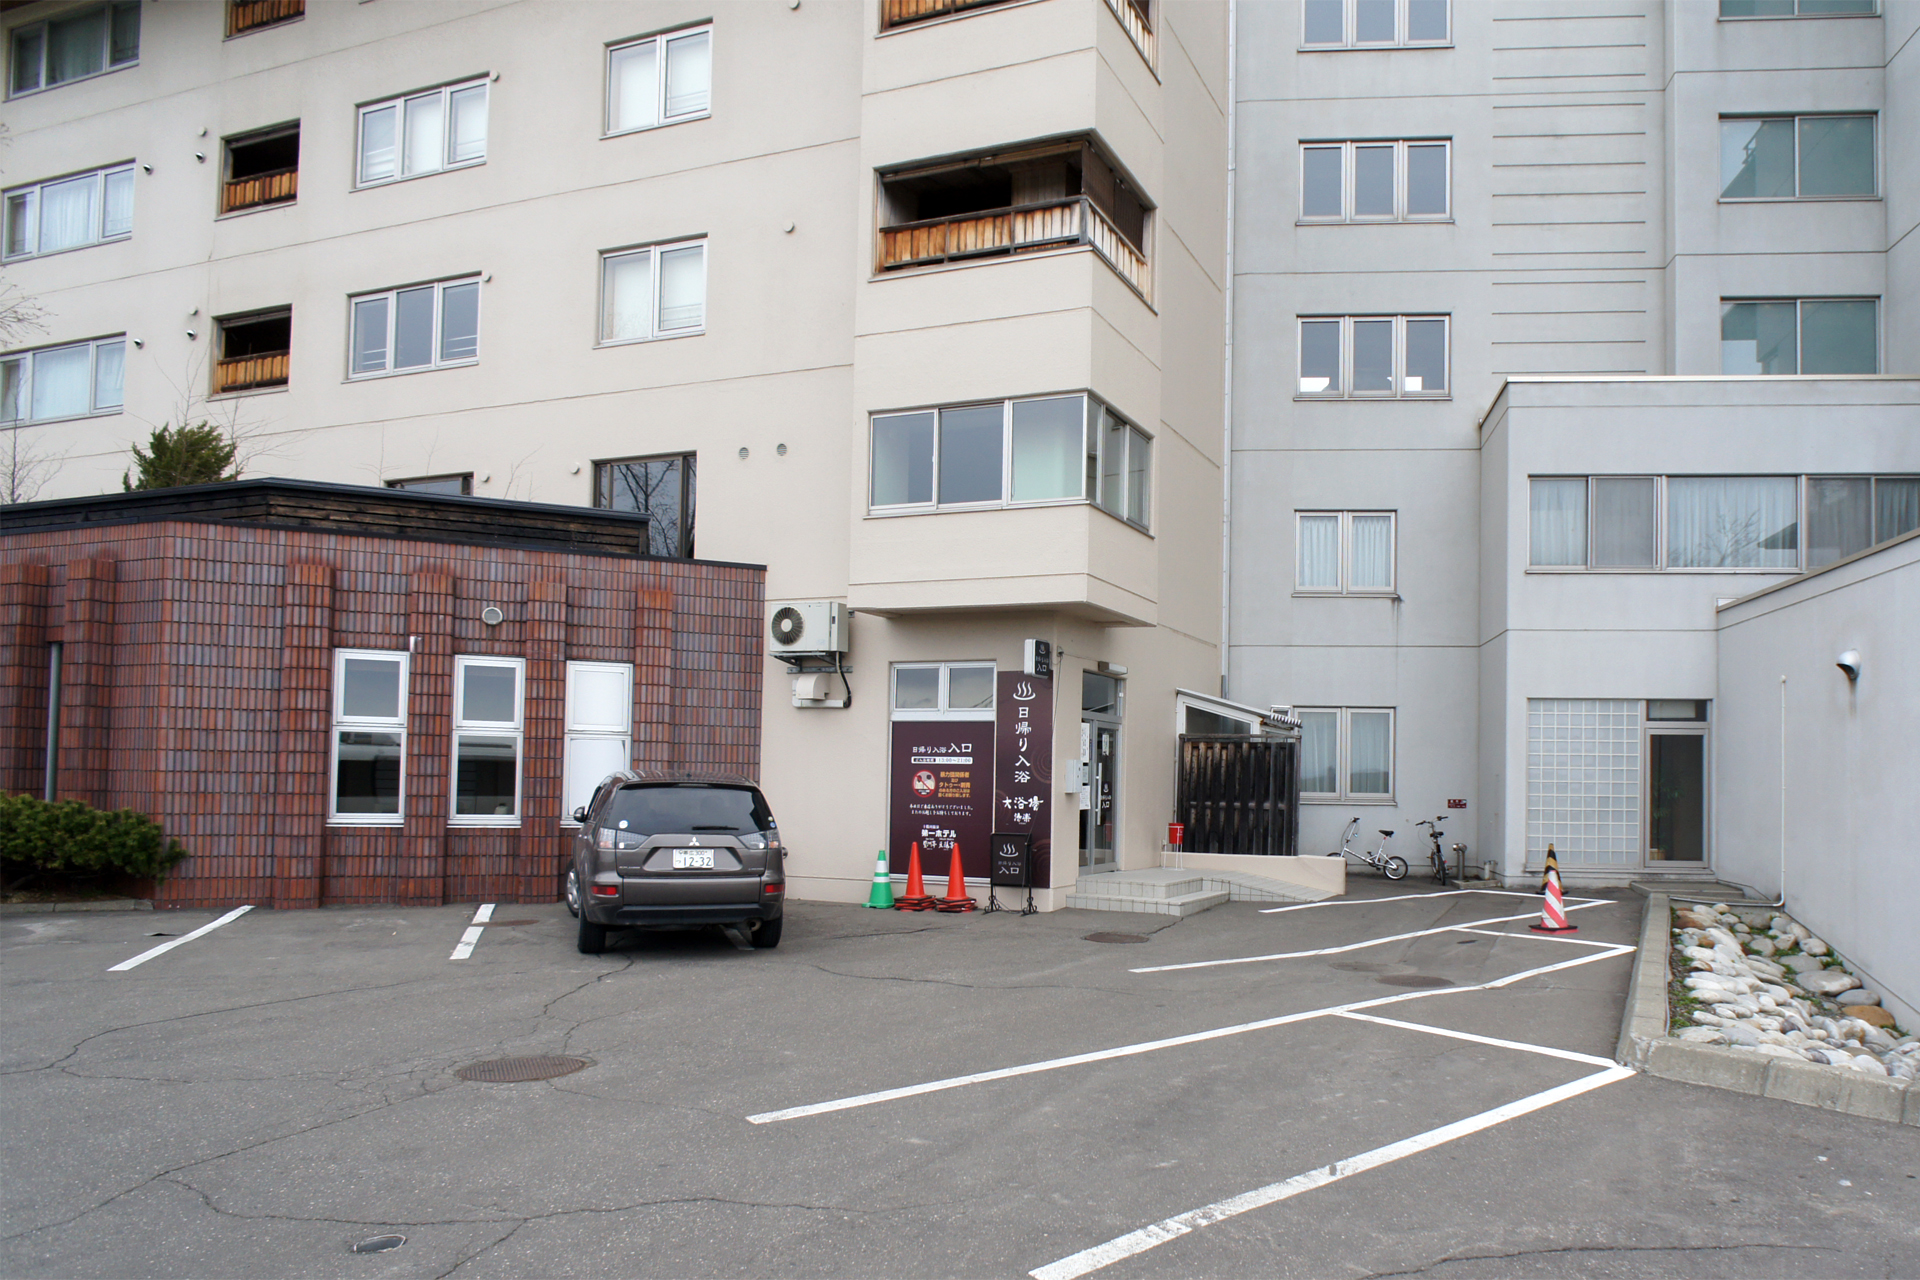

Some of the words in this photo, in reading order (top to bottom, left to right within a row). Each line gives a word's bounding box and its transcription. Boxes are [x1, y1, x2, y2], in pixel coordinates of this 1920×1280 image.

[1036, 664, 1047, 672] 入口
[1014, 706, 1032, 783] 日帰り入浴
[1002, 795, 1044, 811] 大浴場
[921, 829, 957, 838] 第一ホテル
[683, 856, 712, 867] 12-32
[998, 866, 1020, 875] 入口
